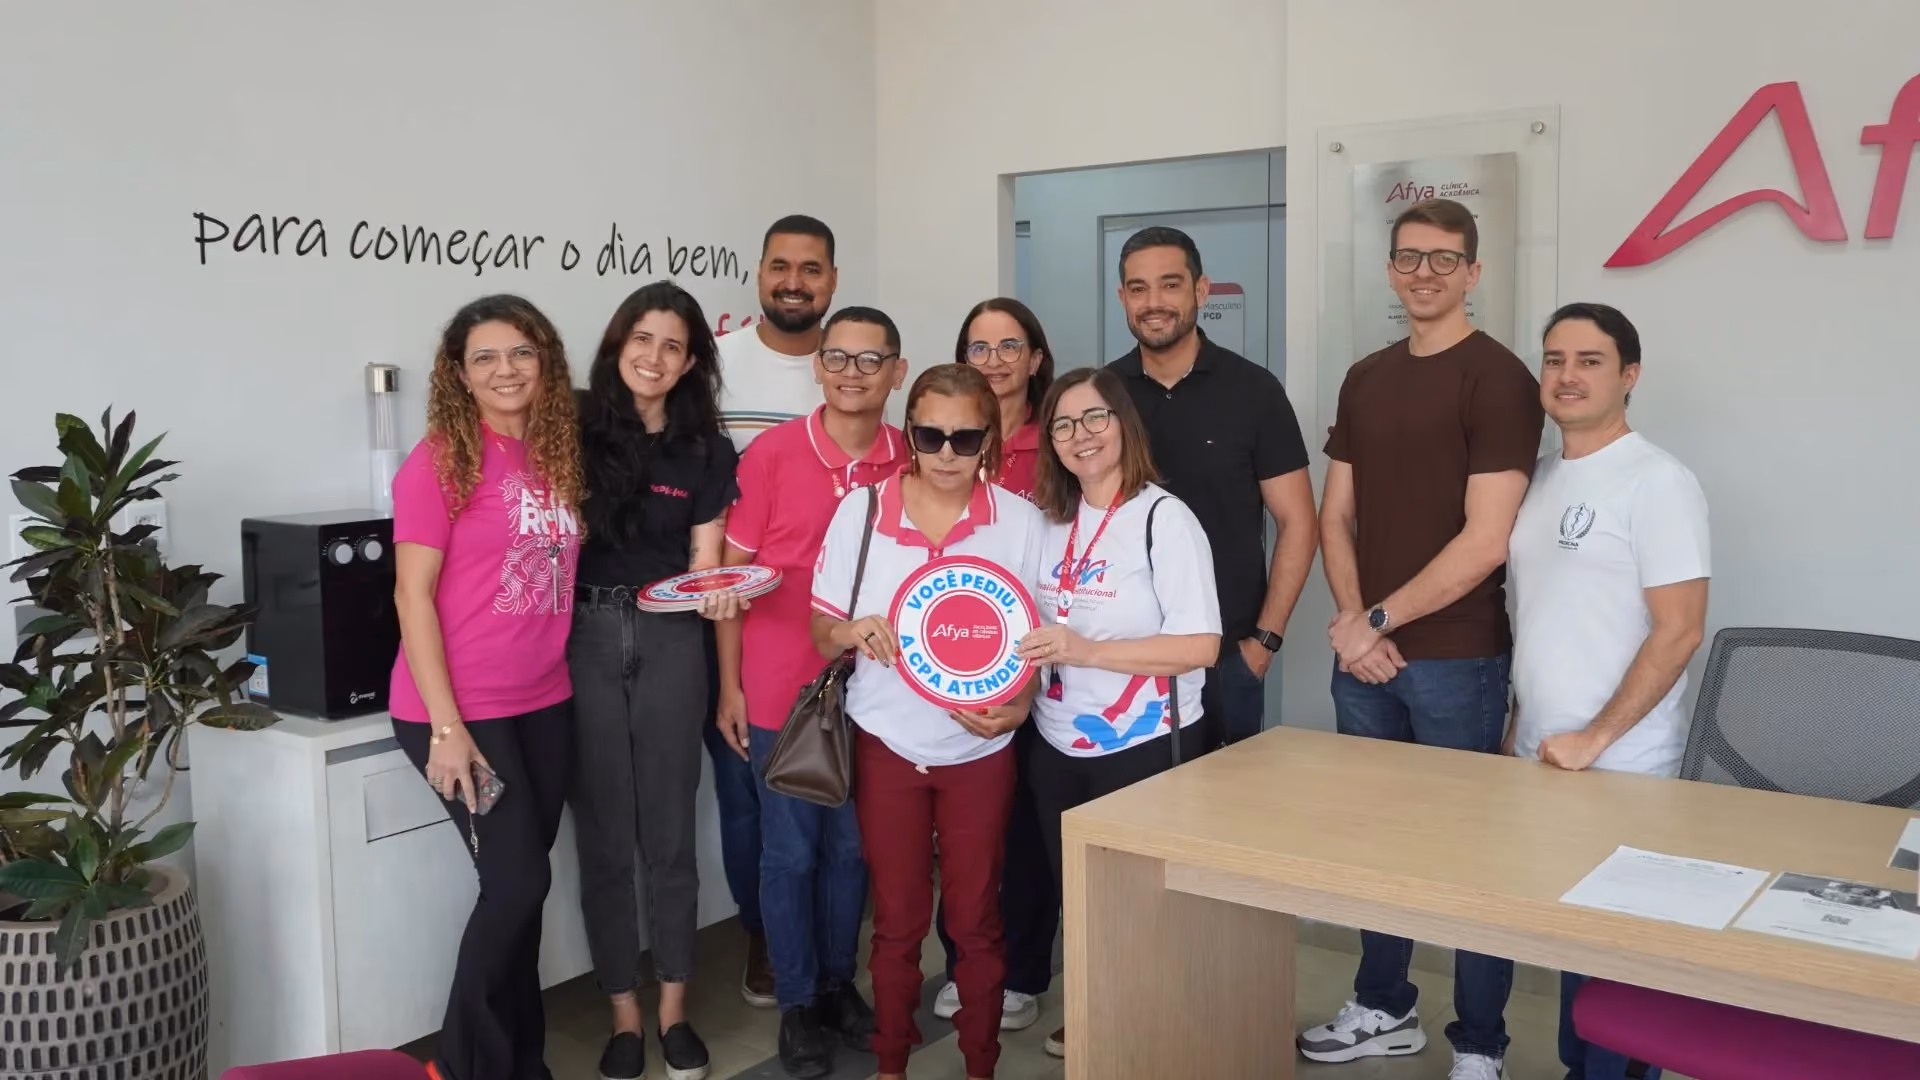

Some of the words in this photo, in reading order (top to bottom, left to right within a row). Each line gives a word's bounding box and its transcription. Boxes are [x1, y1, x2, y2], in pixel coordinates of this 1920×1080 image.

[1385, 181, 1434, 205] Afya
[1439, 188, 1480, 197] ACADÊMICA
[1440, 182, 1468, 190] CLÍNICA
[192, 212, 328, 266] para
[349, 220, 545, 277] começar
[560, 240, 581, 272] o
[596, 222, 653, 277] dia
[667, 236, 750, 286] bem,
[1204, 302, 1242, 311] Masculino
[1203, 312, 1222, 320] PCD
[537, 536, 567, 548] 205
[906, 570, 959, 611] VOCÊ
[961, 572, 1017, 614] PEDIU,
[931, 623, 969, 641] Afya
[900, 634, 916, 650] A
[908, 652, 942, 689] CPA
[946, 640, 1020, 697] ATENDE
